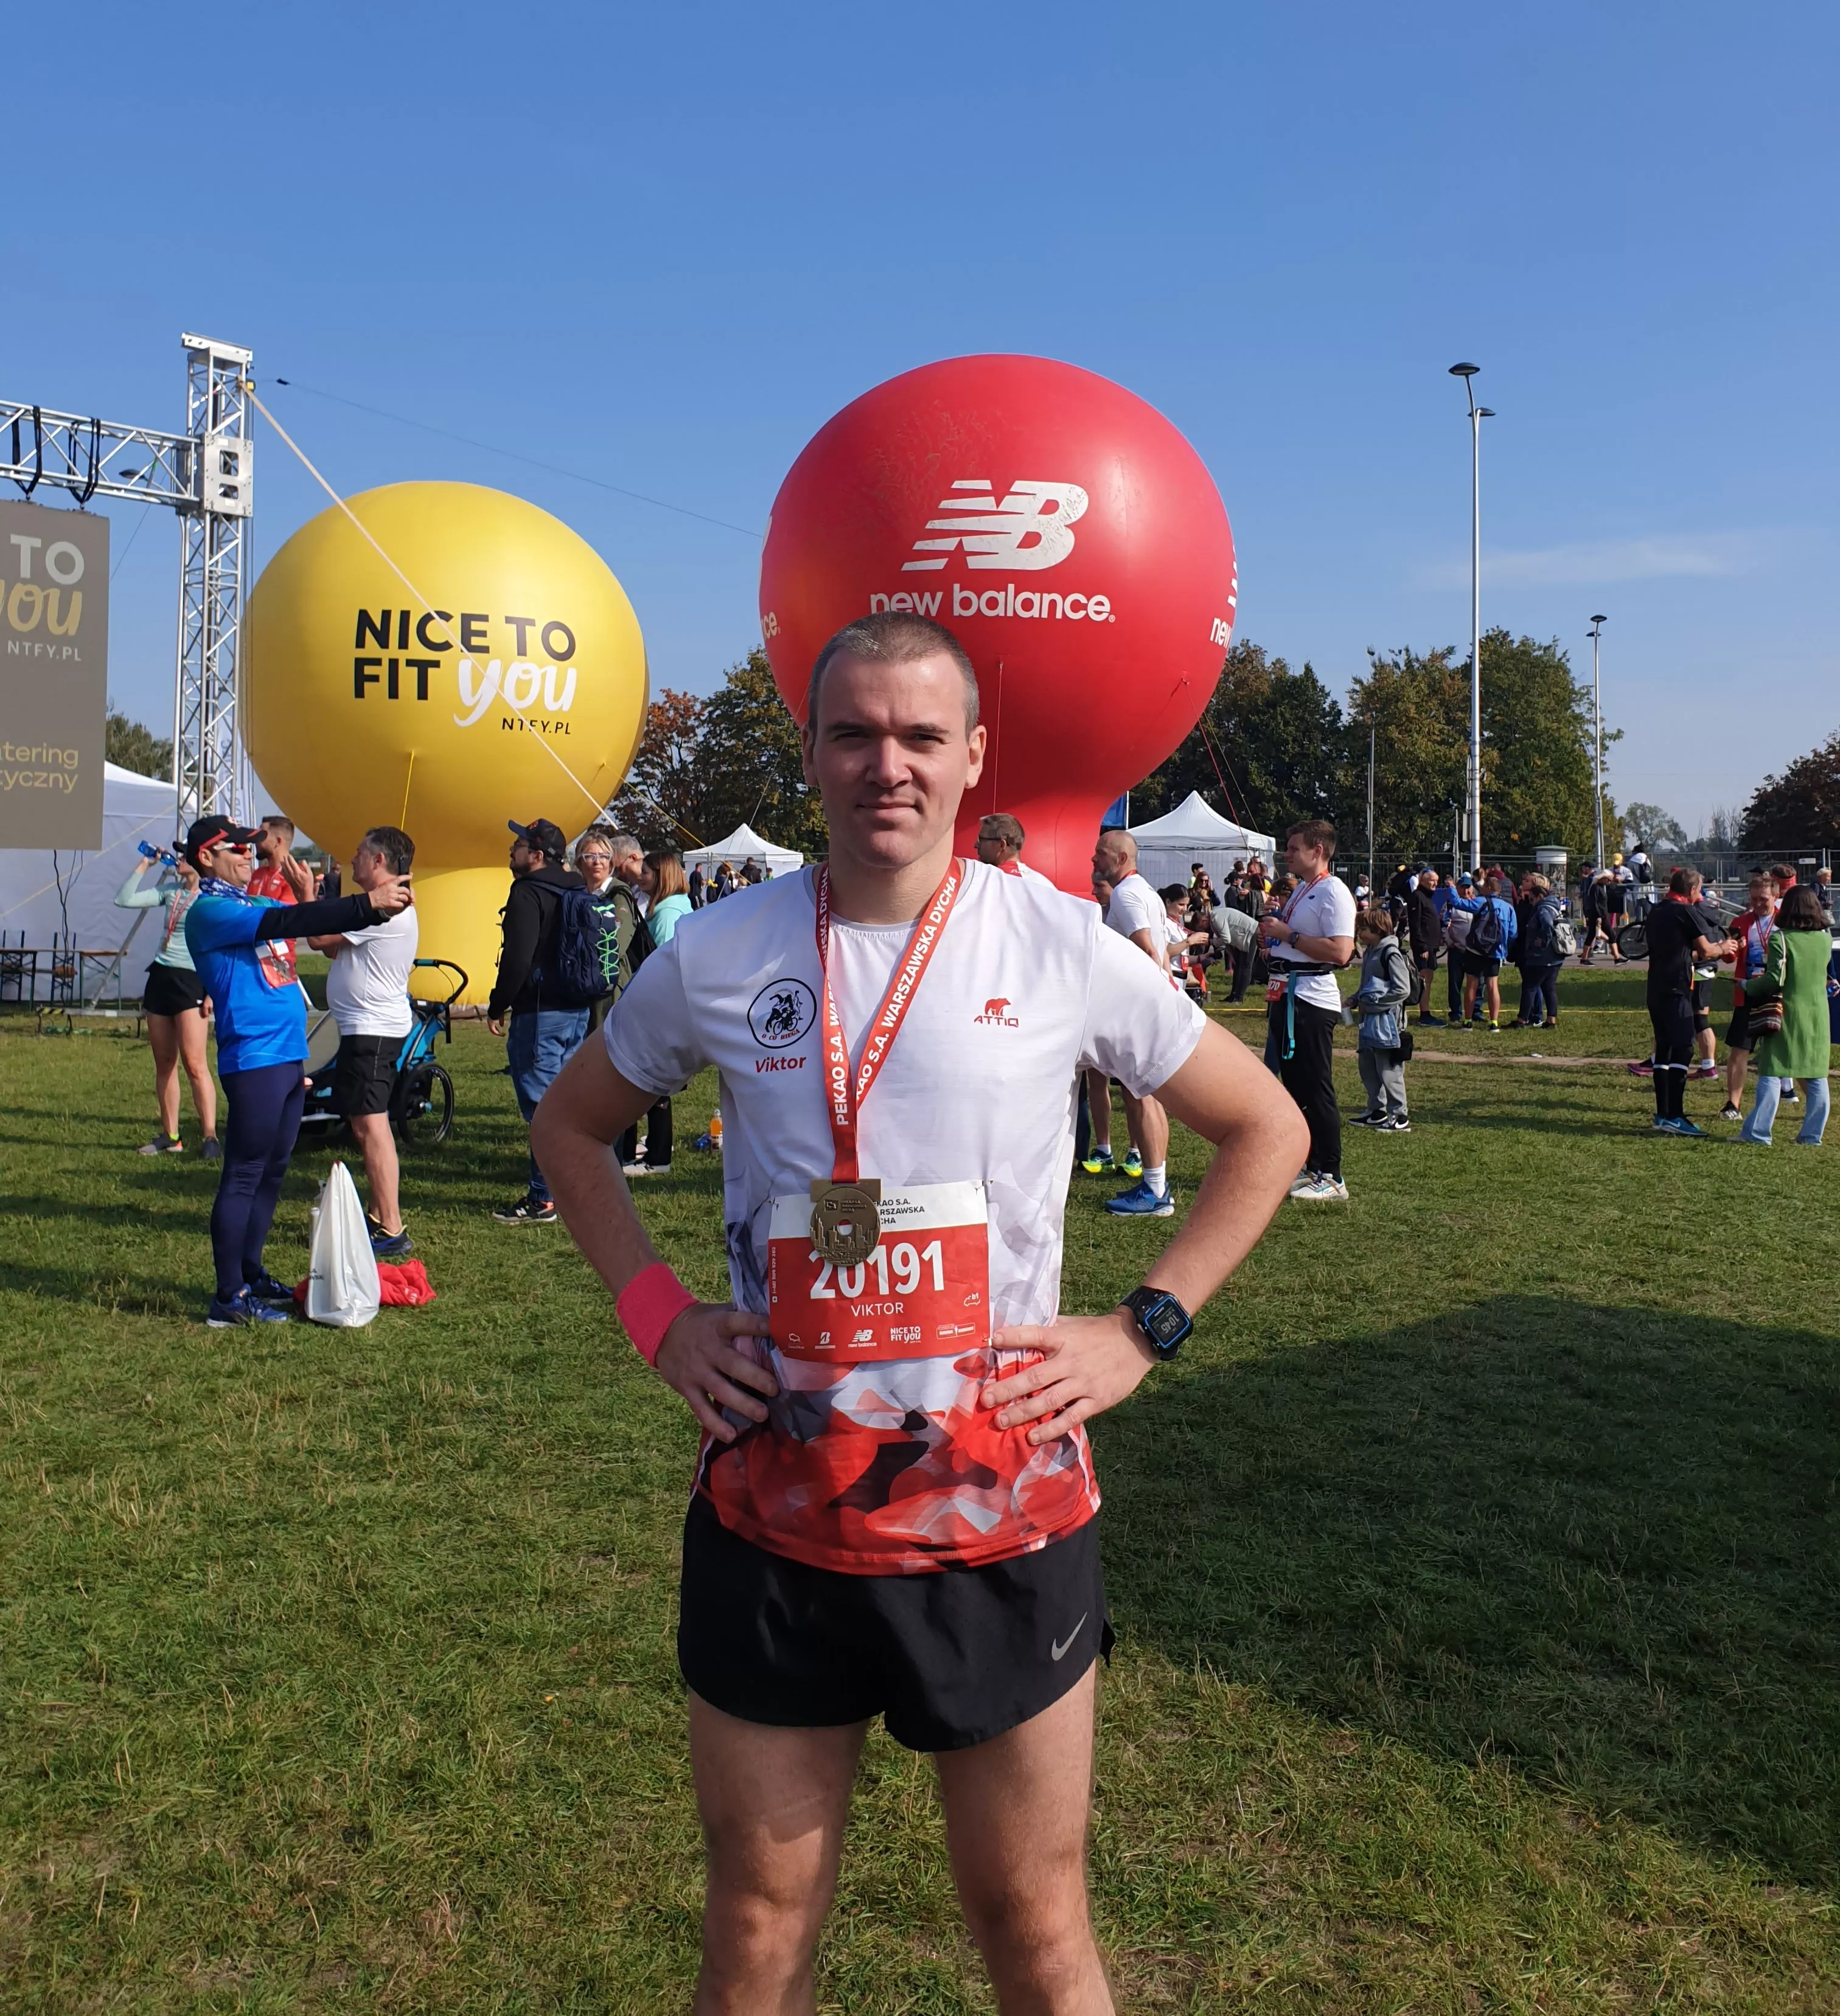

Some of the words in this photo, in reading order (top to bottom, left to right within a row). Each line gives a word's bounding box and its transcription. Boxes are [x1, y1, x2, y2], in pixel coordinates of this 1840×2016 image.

[10, 533, 85, 585] TO
[870, 591, 944, 617] new
[7, 639, 82, 662] NTFY.PL
[355, 608, 490, 655] NICE
[504, 615, 576, 662] TO
[354, 656, 441, 701] FIT
[453, 658, 577, 728] you
[502, 718, 571, 735] NTFY.PL
[856, 1064, 873, 1100] KAO
[868, 1033, 890, 1063] S.A.
[881, 925, 938, 1028] WARSZAWSKA
[930, 876, 957, 924] DYCHA
[830, 1031, 844, 1063] S.A.
[755, 1056, 807, 1073] Viktor
[832, 1066, 849, 1125] PEKAO
[880, 1206, 925, 1215] RSZAWSKA
[809, 1240, 944, 1299] 20191
[851, 1302, 904, 1317] VIKTOR
